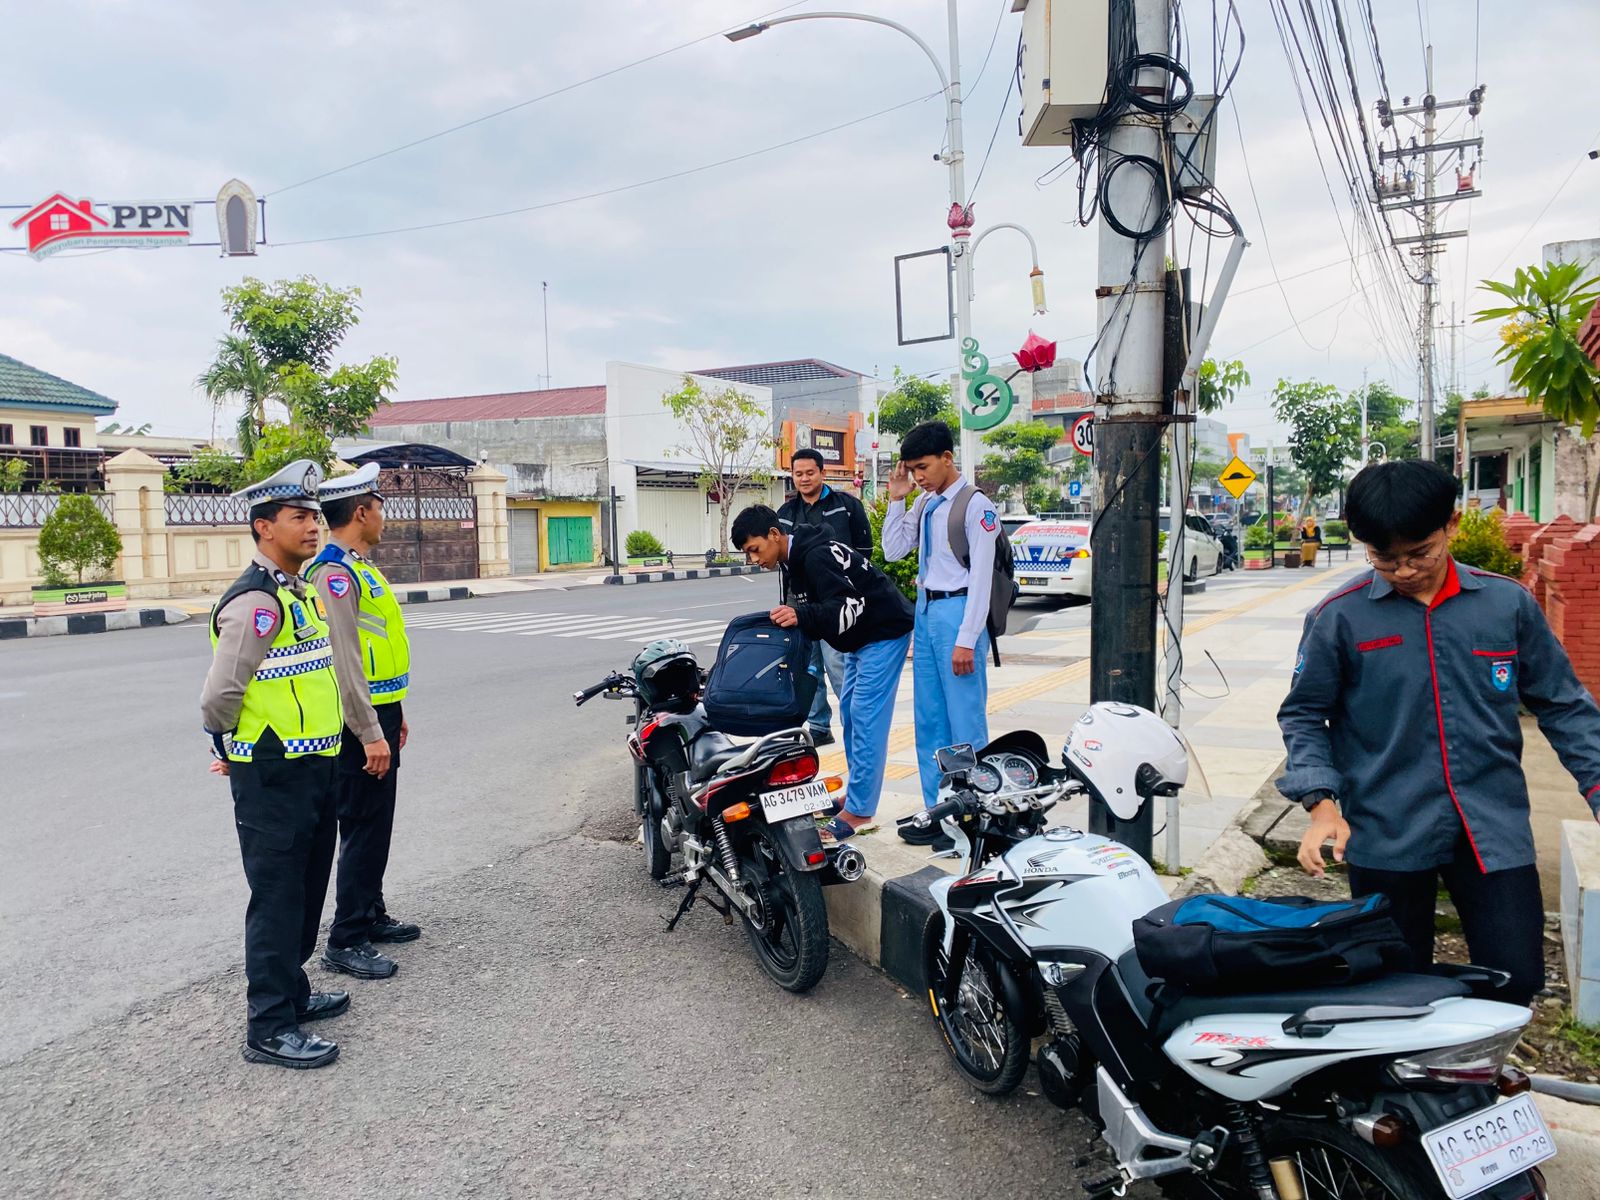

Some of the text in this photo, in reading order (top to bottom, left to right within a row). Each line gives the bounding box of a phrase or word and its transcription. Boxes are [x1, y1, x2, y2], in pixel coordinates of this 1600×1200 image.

[112, 205, 191, 229] PPN
[86, 238, 145, 246] Pengembang
[146, 237, 183, 246] Nganjuk
[1077, 424, 1094, 447] 30
[763, 783, 827, 809] AG 3479 VAM
[1023, 866, 1059, 874] HONDA
[1437, 1136, 1465, 1169] AG
[1463, 1116, 1512, 1156] 5636
